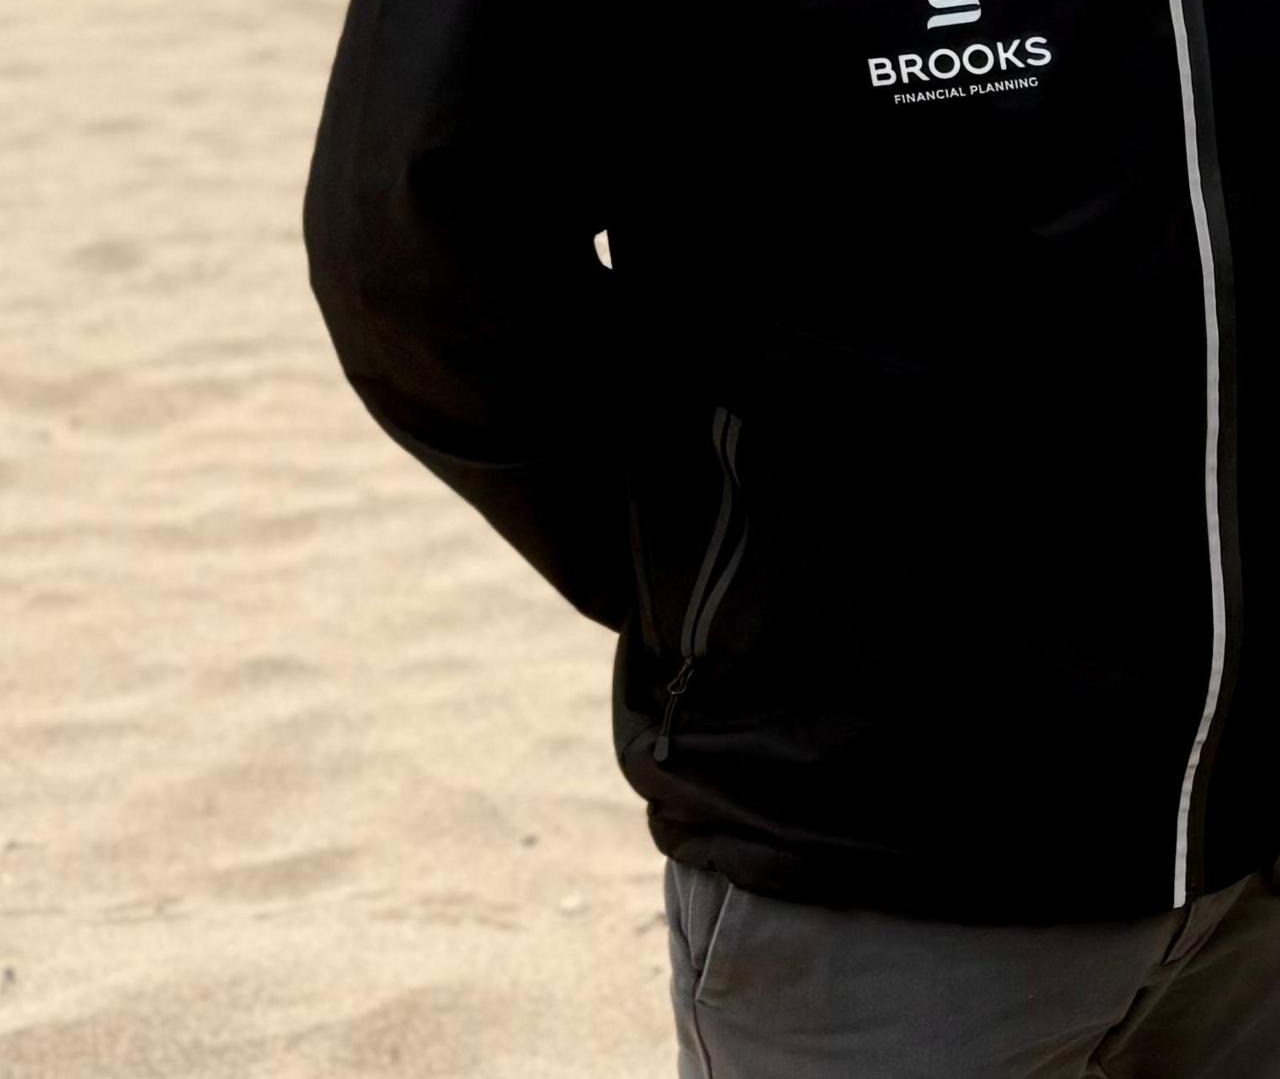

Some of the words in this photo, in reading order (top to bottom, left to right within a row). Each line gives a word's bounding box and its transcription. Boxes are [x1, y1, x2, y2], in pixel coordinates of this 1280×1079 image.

[867, 36, 1052, 87] BROOKS
[894, 87, 967, 105] FINANCIAL
[969, 76, 1039, 96] PLANNING
